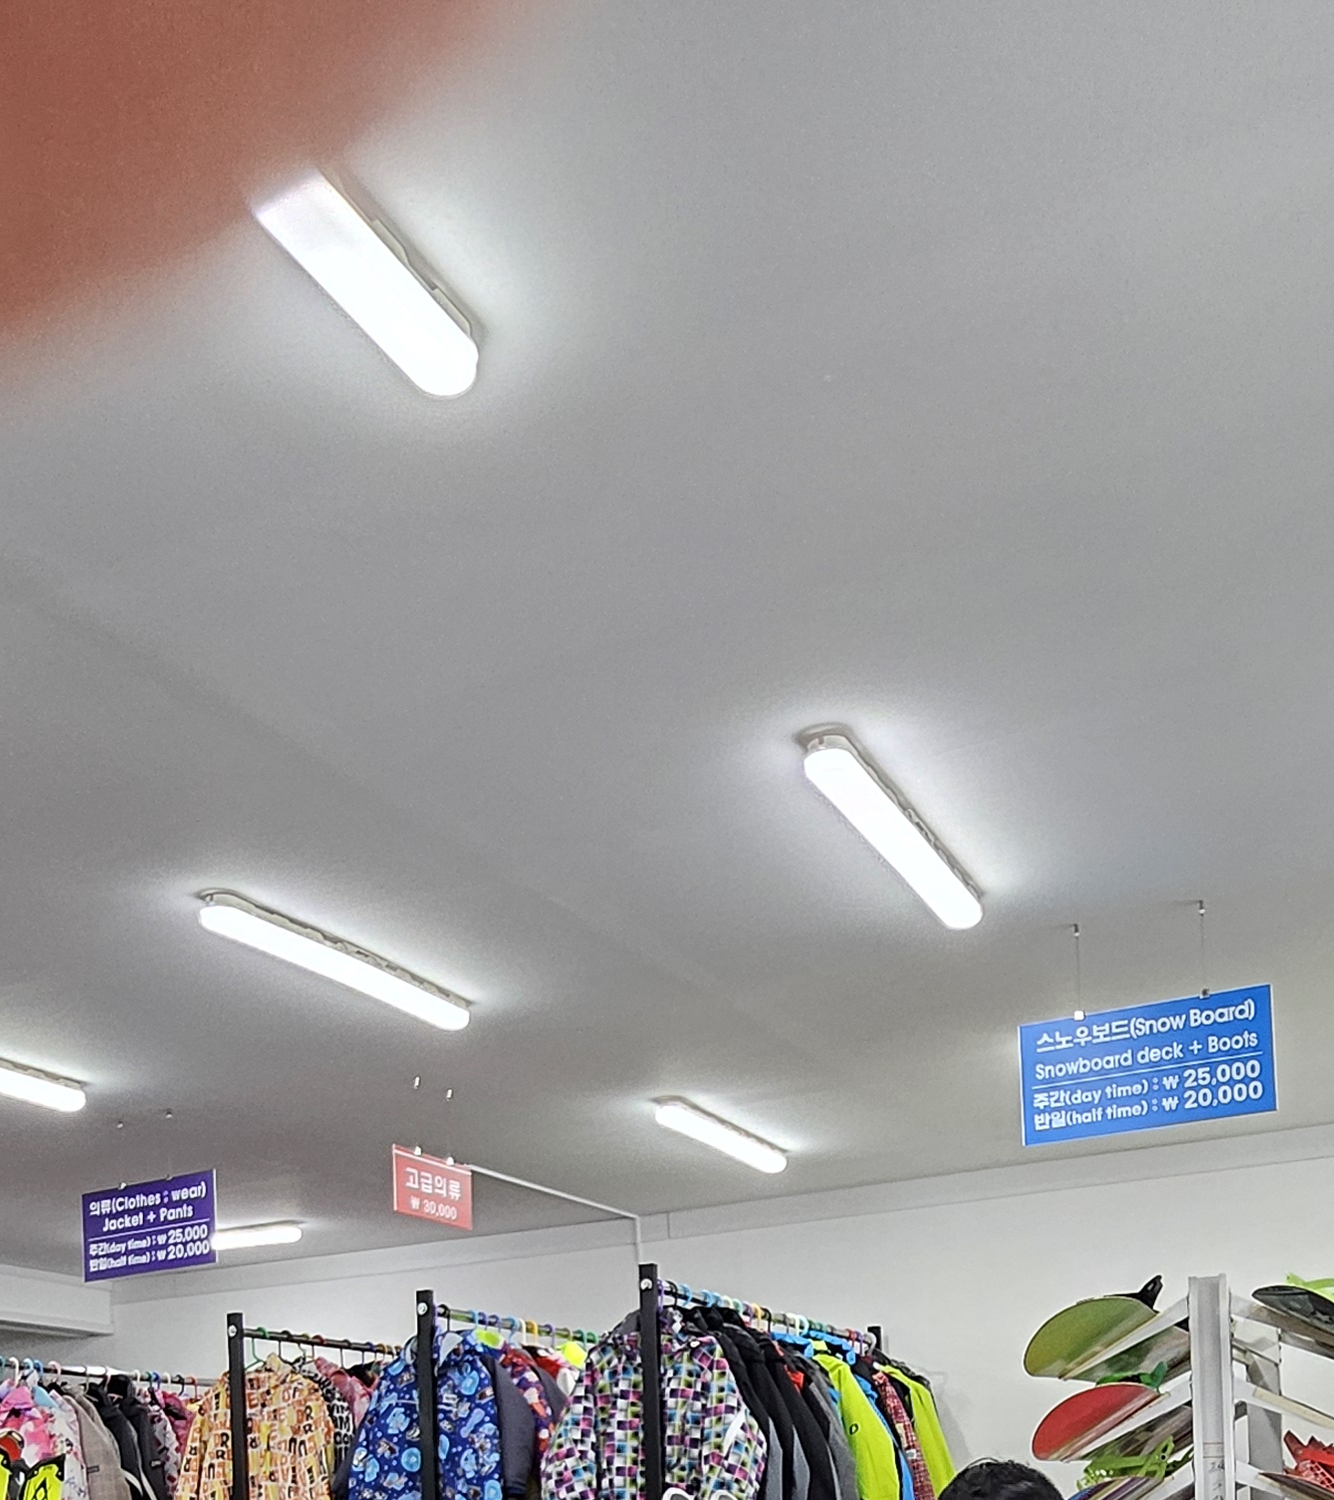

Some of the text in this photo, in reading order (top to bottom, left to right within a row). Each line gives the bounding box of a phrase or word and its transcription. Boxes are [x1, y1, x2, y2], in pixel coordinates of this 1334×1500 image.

[1036, 998, 1256, 1052] 스노우보드(Snow Board)
[1035, 1049, 1132, 1080] Snowboard
[1136, 1042, 1184, 1066] deck
[1208, 1031, 1258, 1053] Boots
[1033, 1084, 1102, 1111] 주간(day
[1183, 1060, 1260, 1088] 25,000
[1034, 1105, 1104, 1132] 반일(half
[1183, 1081, 1263, 1110] 20,000
[171, 1181, 206, 1201] wear)
[405, 1167, 461, 1200] 고급의류
[102, 1212, 143, 1232] Jacket
[159, 1203, 193, 1222] Pants
[167, 1224, 208, 1244] 25,000
[167, 1240, 209, 1260] 20,000
